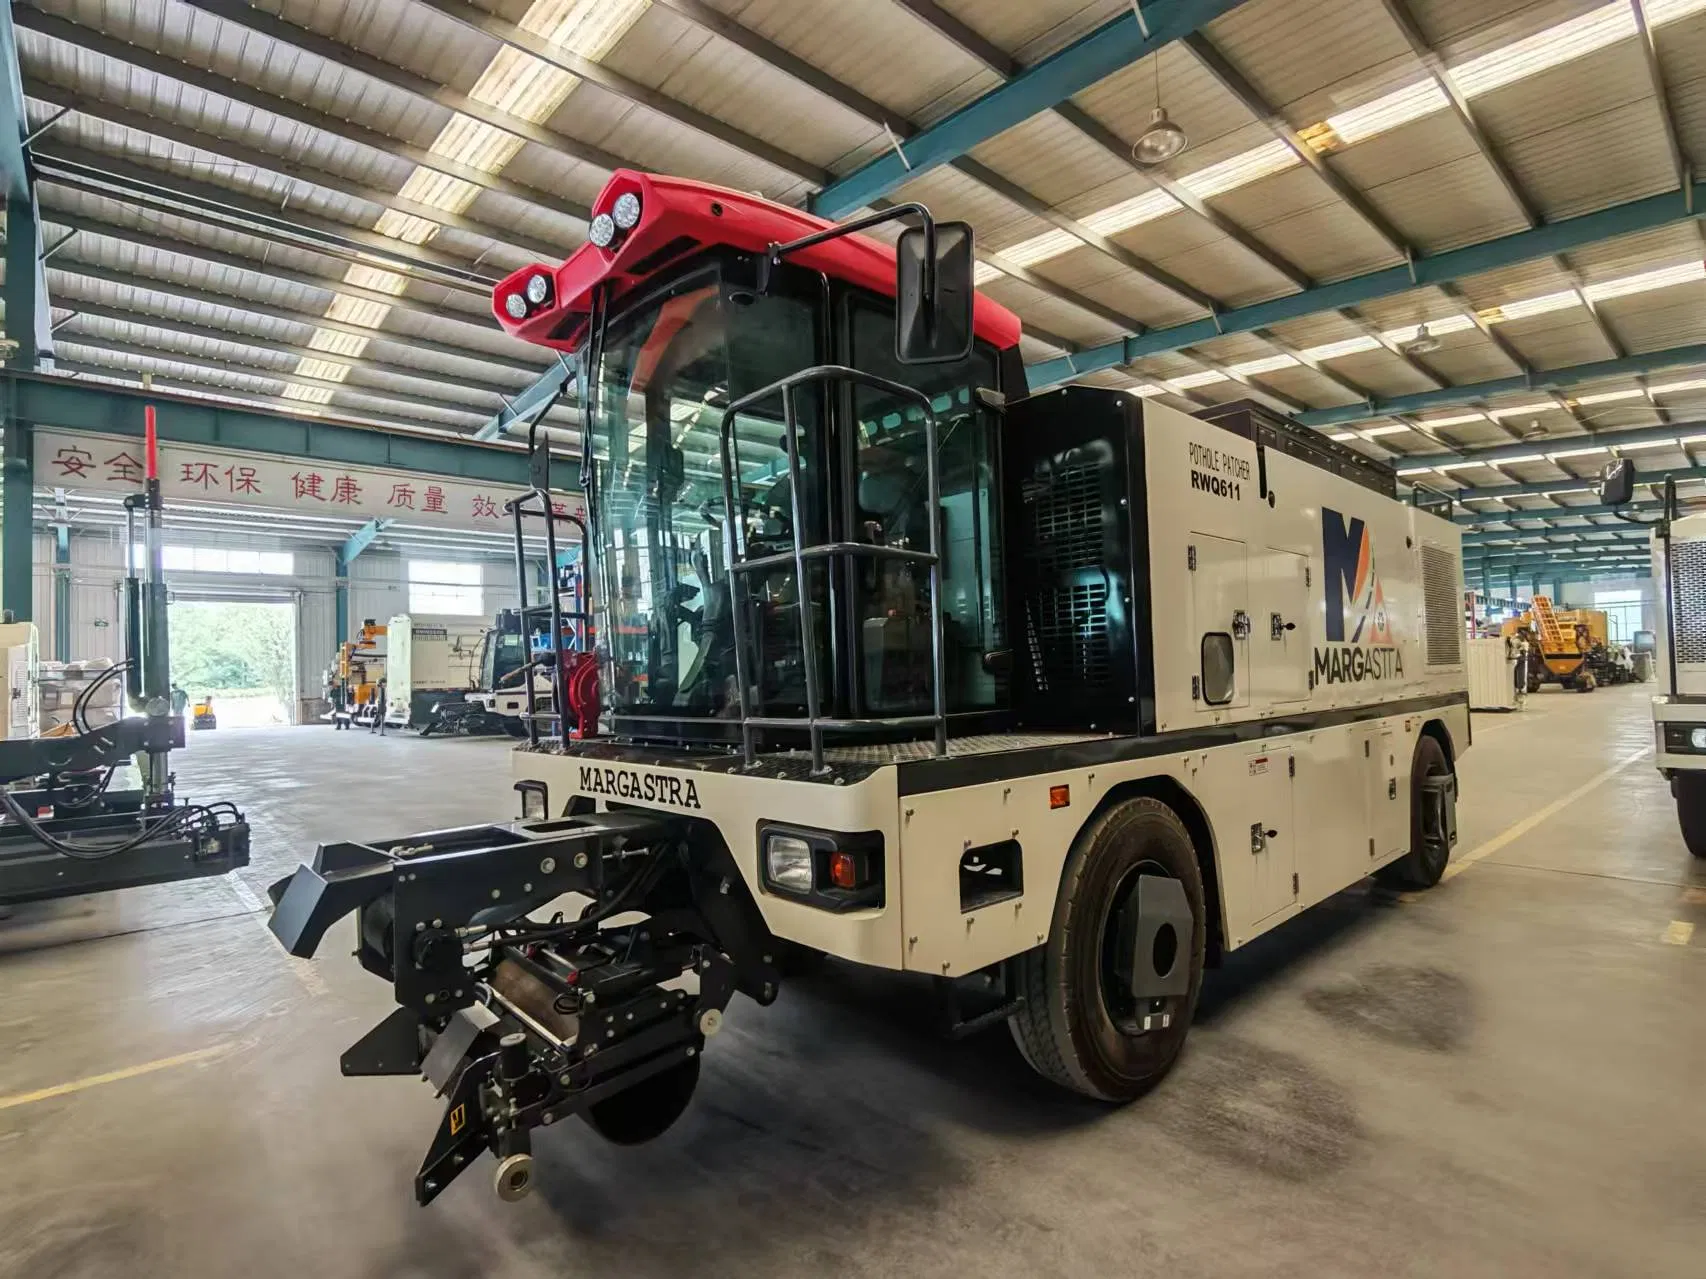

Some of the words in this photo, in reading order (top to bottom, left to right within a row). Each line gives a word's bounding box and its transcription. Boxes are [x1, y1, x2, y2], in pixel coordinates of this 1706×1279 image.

[52, 444, 143, 484] 安全
[180, 462, 262, 494] 环保
[291, 472, 363, 505] 健康
[387, 483, 449, 514] 质量
[1189, 441, 1220, 472] POTHOLE
[1222, 453, 1250, 481] PATCHER
[1191, 469, 1240, 501] RWQ611
[579, 766, 701, 809] MARGASTRA
